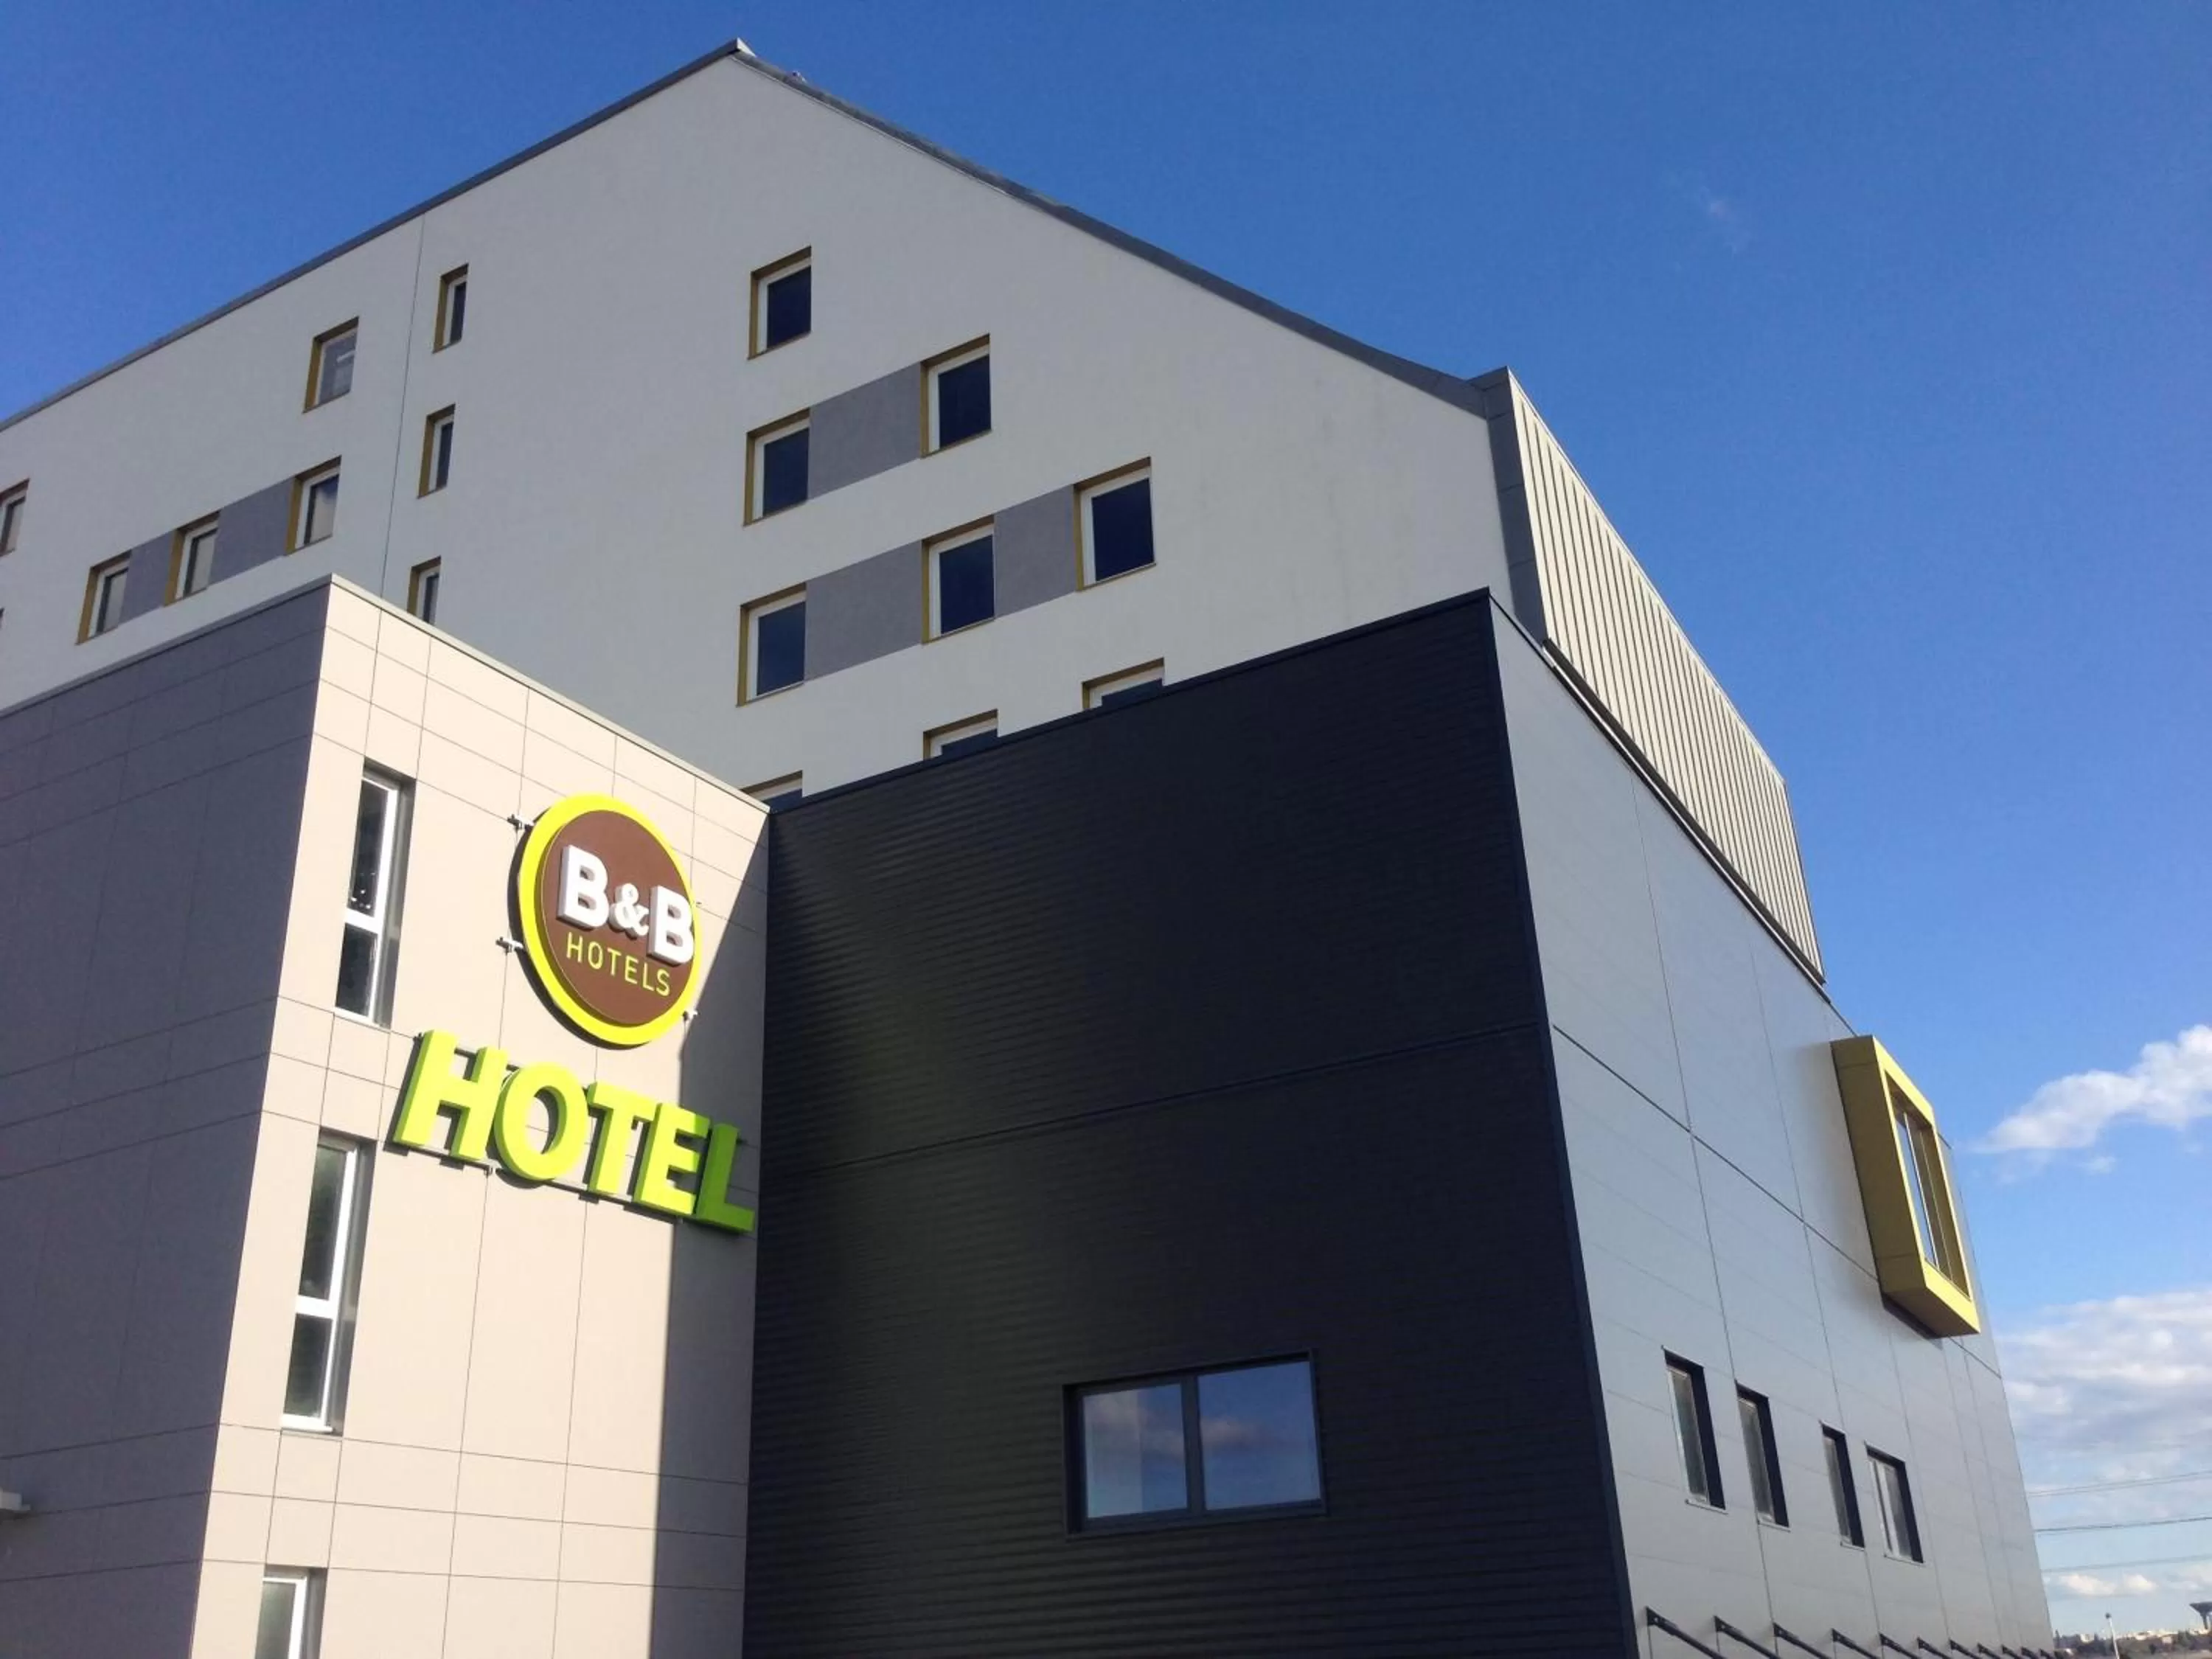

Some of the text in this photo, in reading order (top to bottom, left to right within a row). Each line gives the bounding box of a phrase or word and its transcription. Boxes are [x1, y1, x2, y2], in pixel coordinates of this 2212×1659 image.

[558, 844, 695, 965] B&B
[566, 932, 670, 996] HOTELS
[393, 1029, 756, 1233] HOTEL
